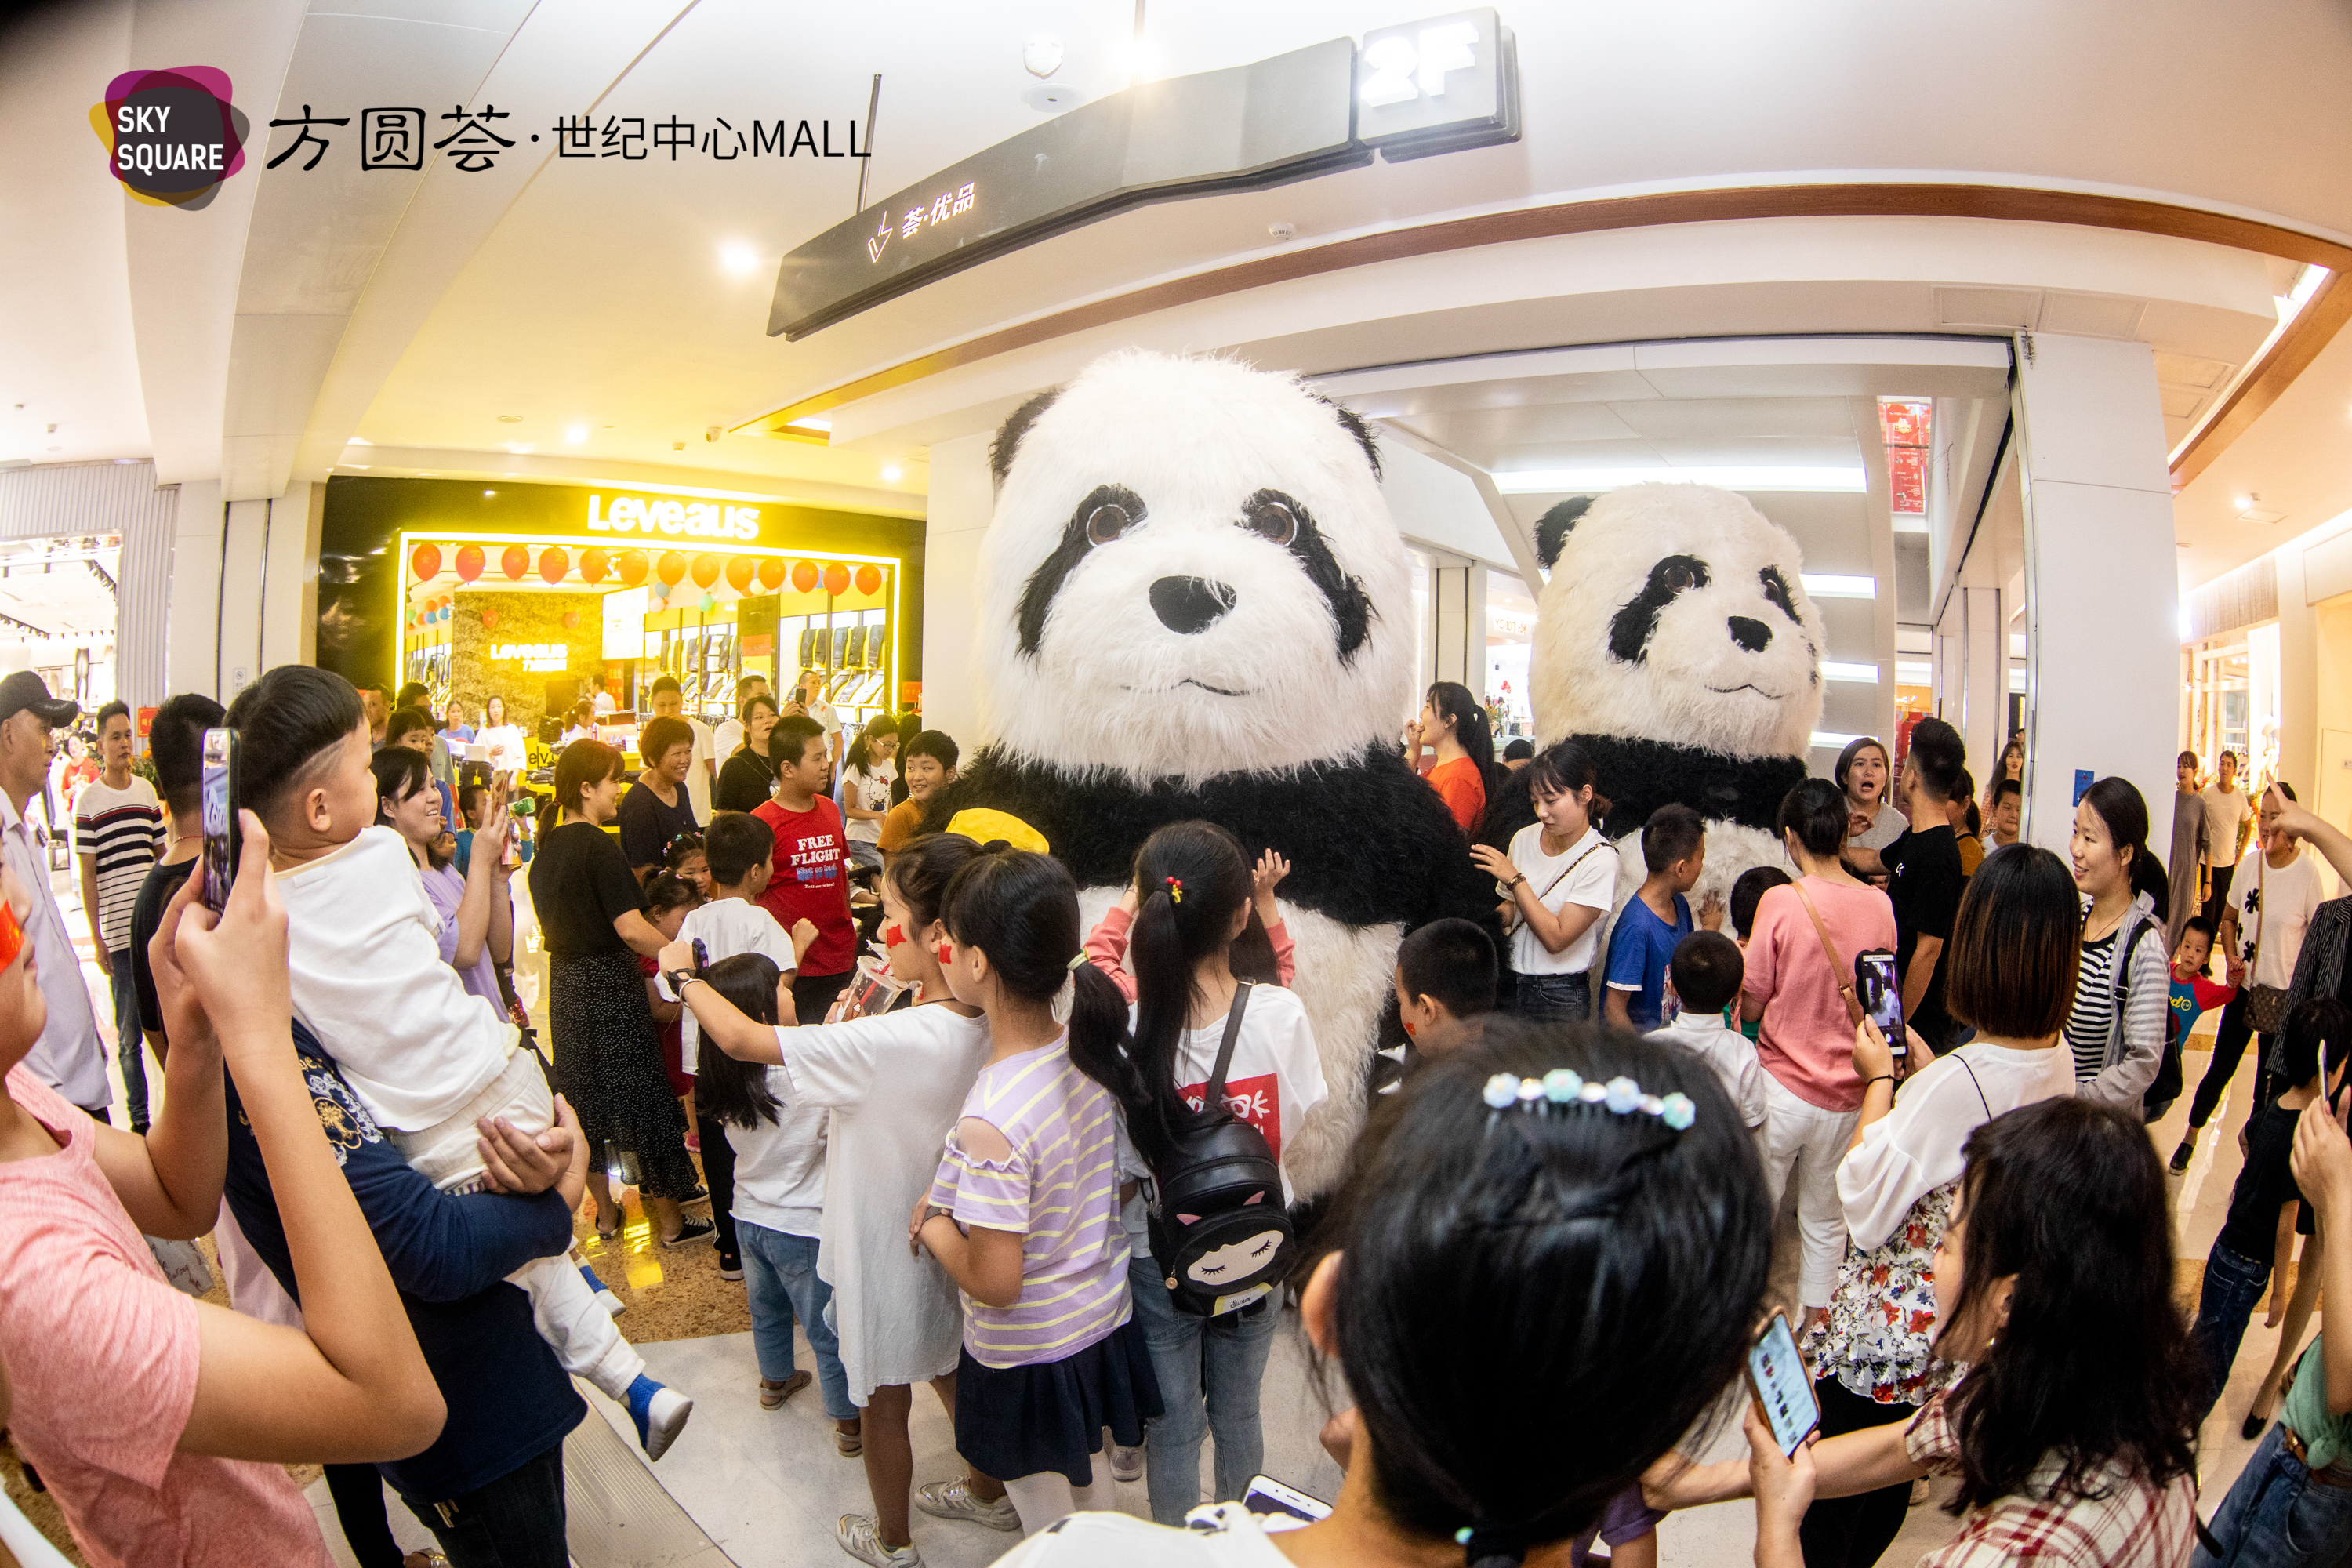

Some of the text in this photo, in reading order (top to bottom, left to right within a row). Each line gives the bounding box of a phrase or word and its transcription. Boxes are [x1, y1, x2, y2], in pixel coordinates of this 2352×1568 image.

[1361, 21, 1479, 107] 2F
[902, 181, 975, 239] 荟·优品
[587, 495, 760, 540] Leveaus
[790, 848, 840, 866] FLIGHT
[797, 834, 834, 851] FREE
[797, 867, 814, 877] Not
